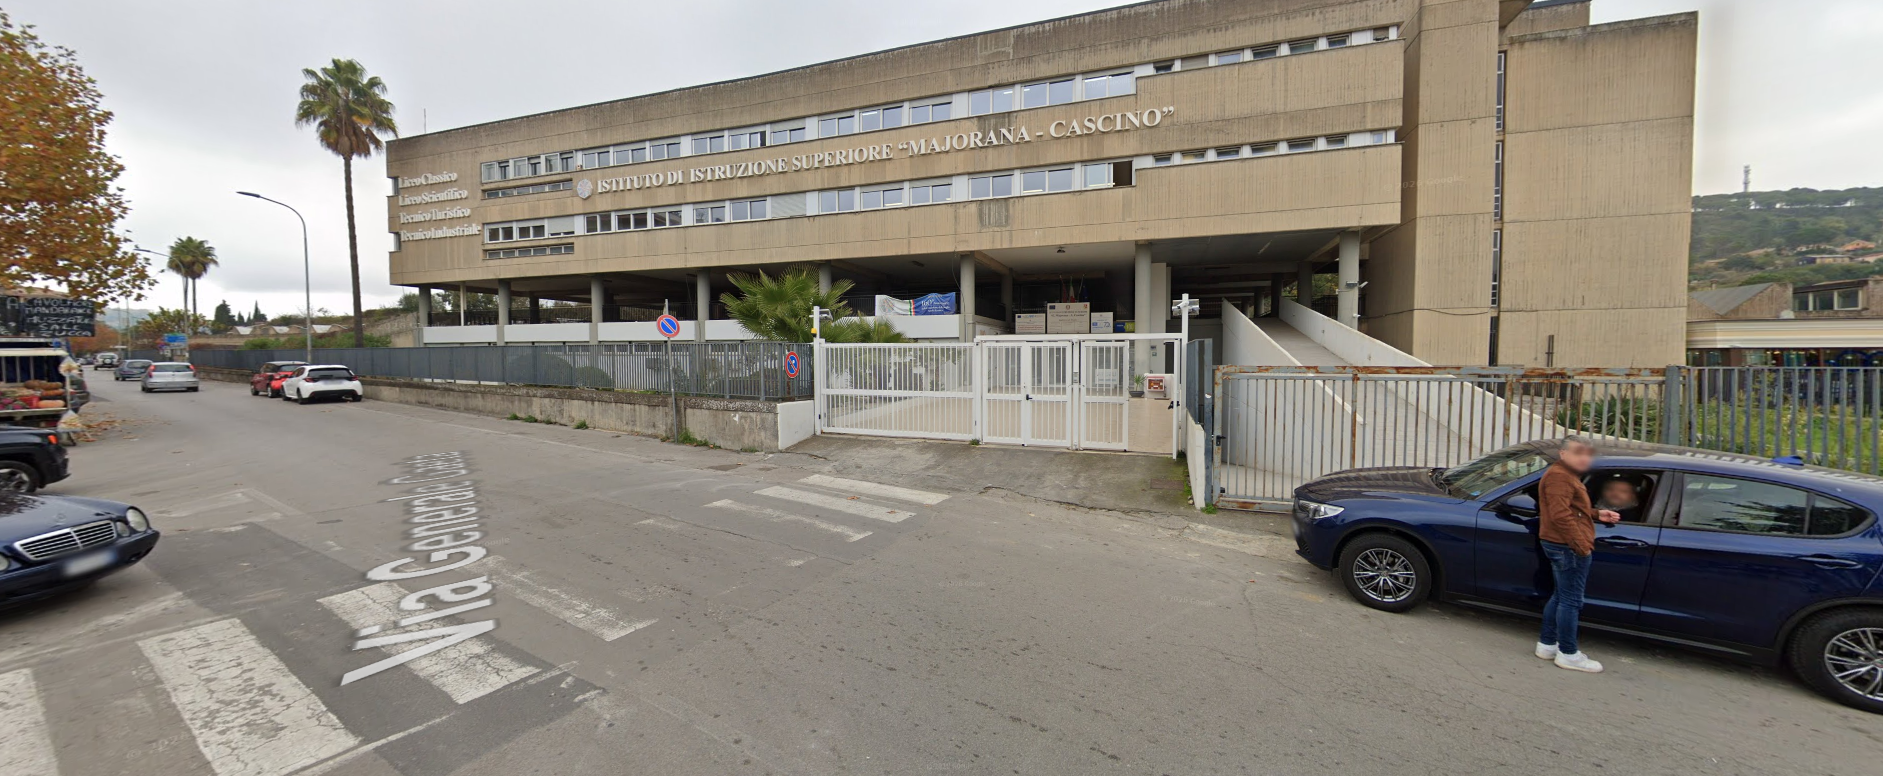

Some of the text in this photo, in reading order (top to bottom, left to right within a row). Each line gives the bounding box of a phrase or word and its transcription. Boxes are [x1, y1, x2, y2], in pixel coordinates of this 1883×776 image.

[597, 172, 664, 193] ISTITUTO
[668, 170, 684, 186] DI
[690, 157, 788, 182] ISTRUZIONE
[792, 143, 894, 171] SUPERIORE
[898, 125, 1031, 156] “MAJORANA
[1050, 106, 1174, 138] CASCINO”
[398, 171, 458, 189] Liceo Classico
[399, 188, 468, 206] Liceo Scientifico
[400, 206, 471, 224] Tecnico Turistico
[400, 224, 481, 242] Tecnico Industriale
